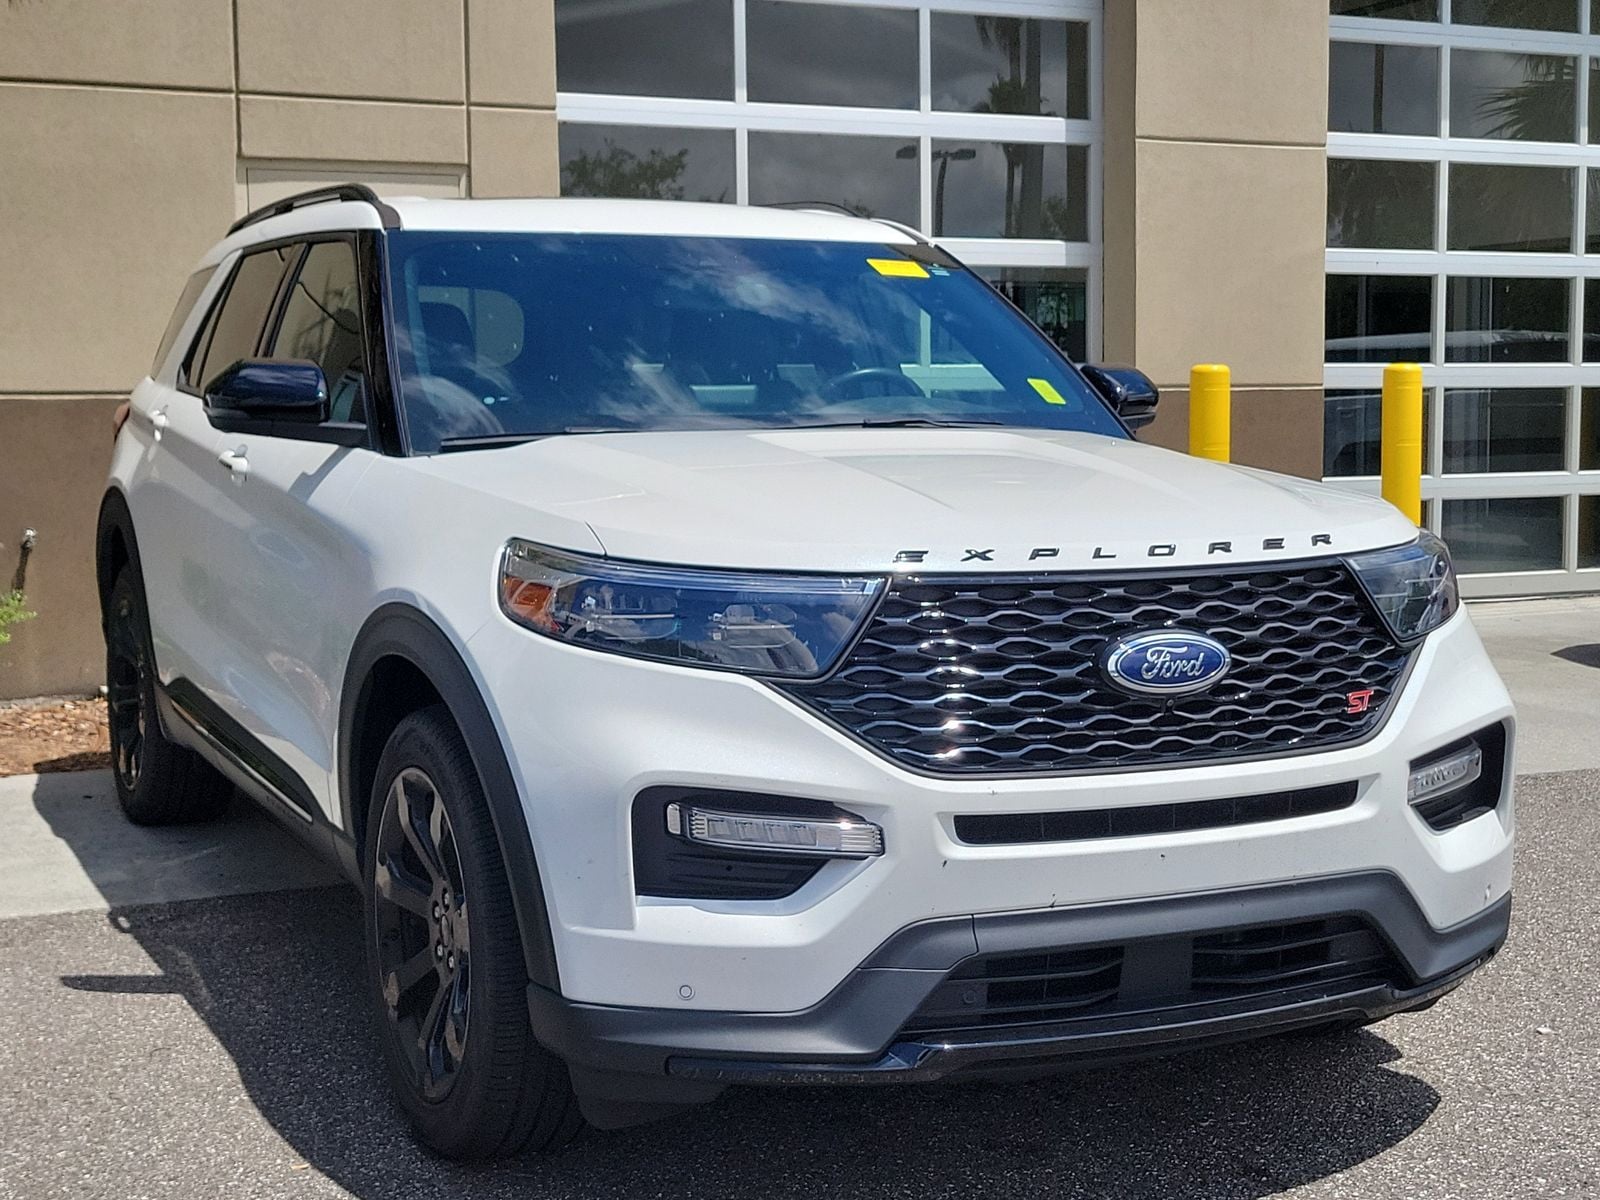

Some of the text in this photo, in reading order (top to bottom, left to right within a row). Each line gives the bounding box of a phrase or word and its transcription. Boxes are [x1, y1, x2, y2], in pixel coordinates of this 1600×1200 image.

[892, 533, 1333, 563] EXPLORER
[1141, 646, 1205, 680] Ford
[1347, 690, 1374, 714] ST
